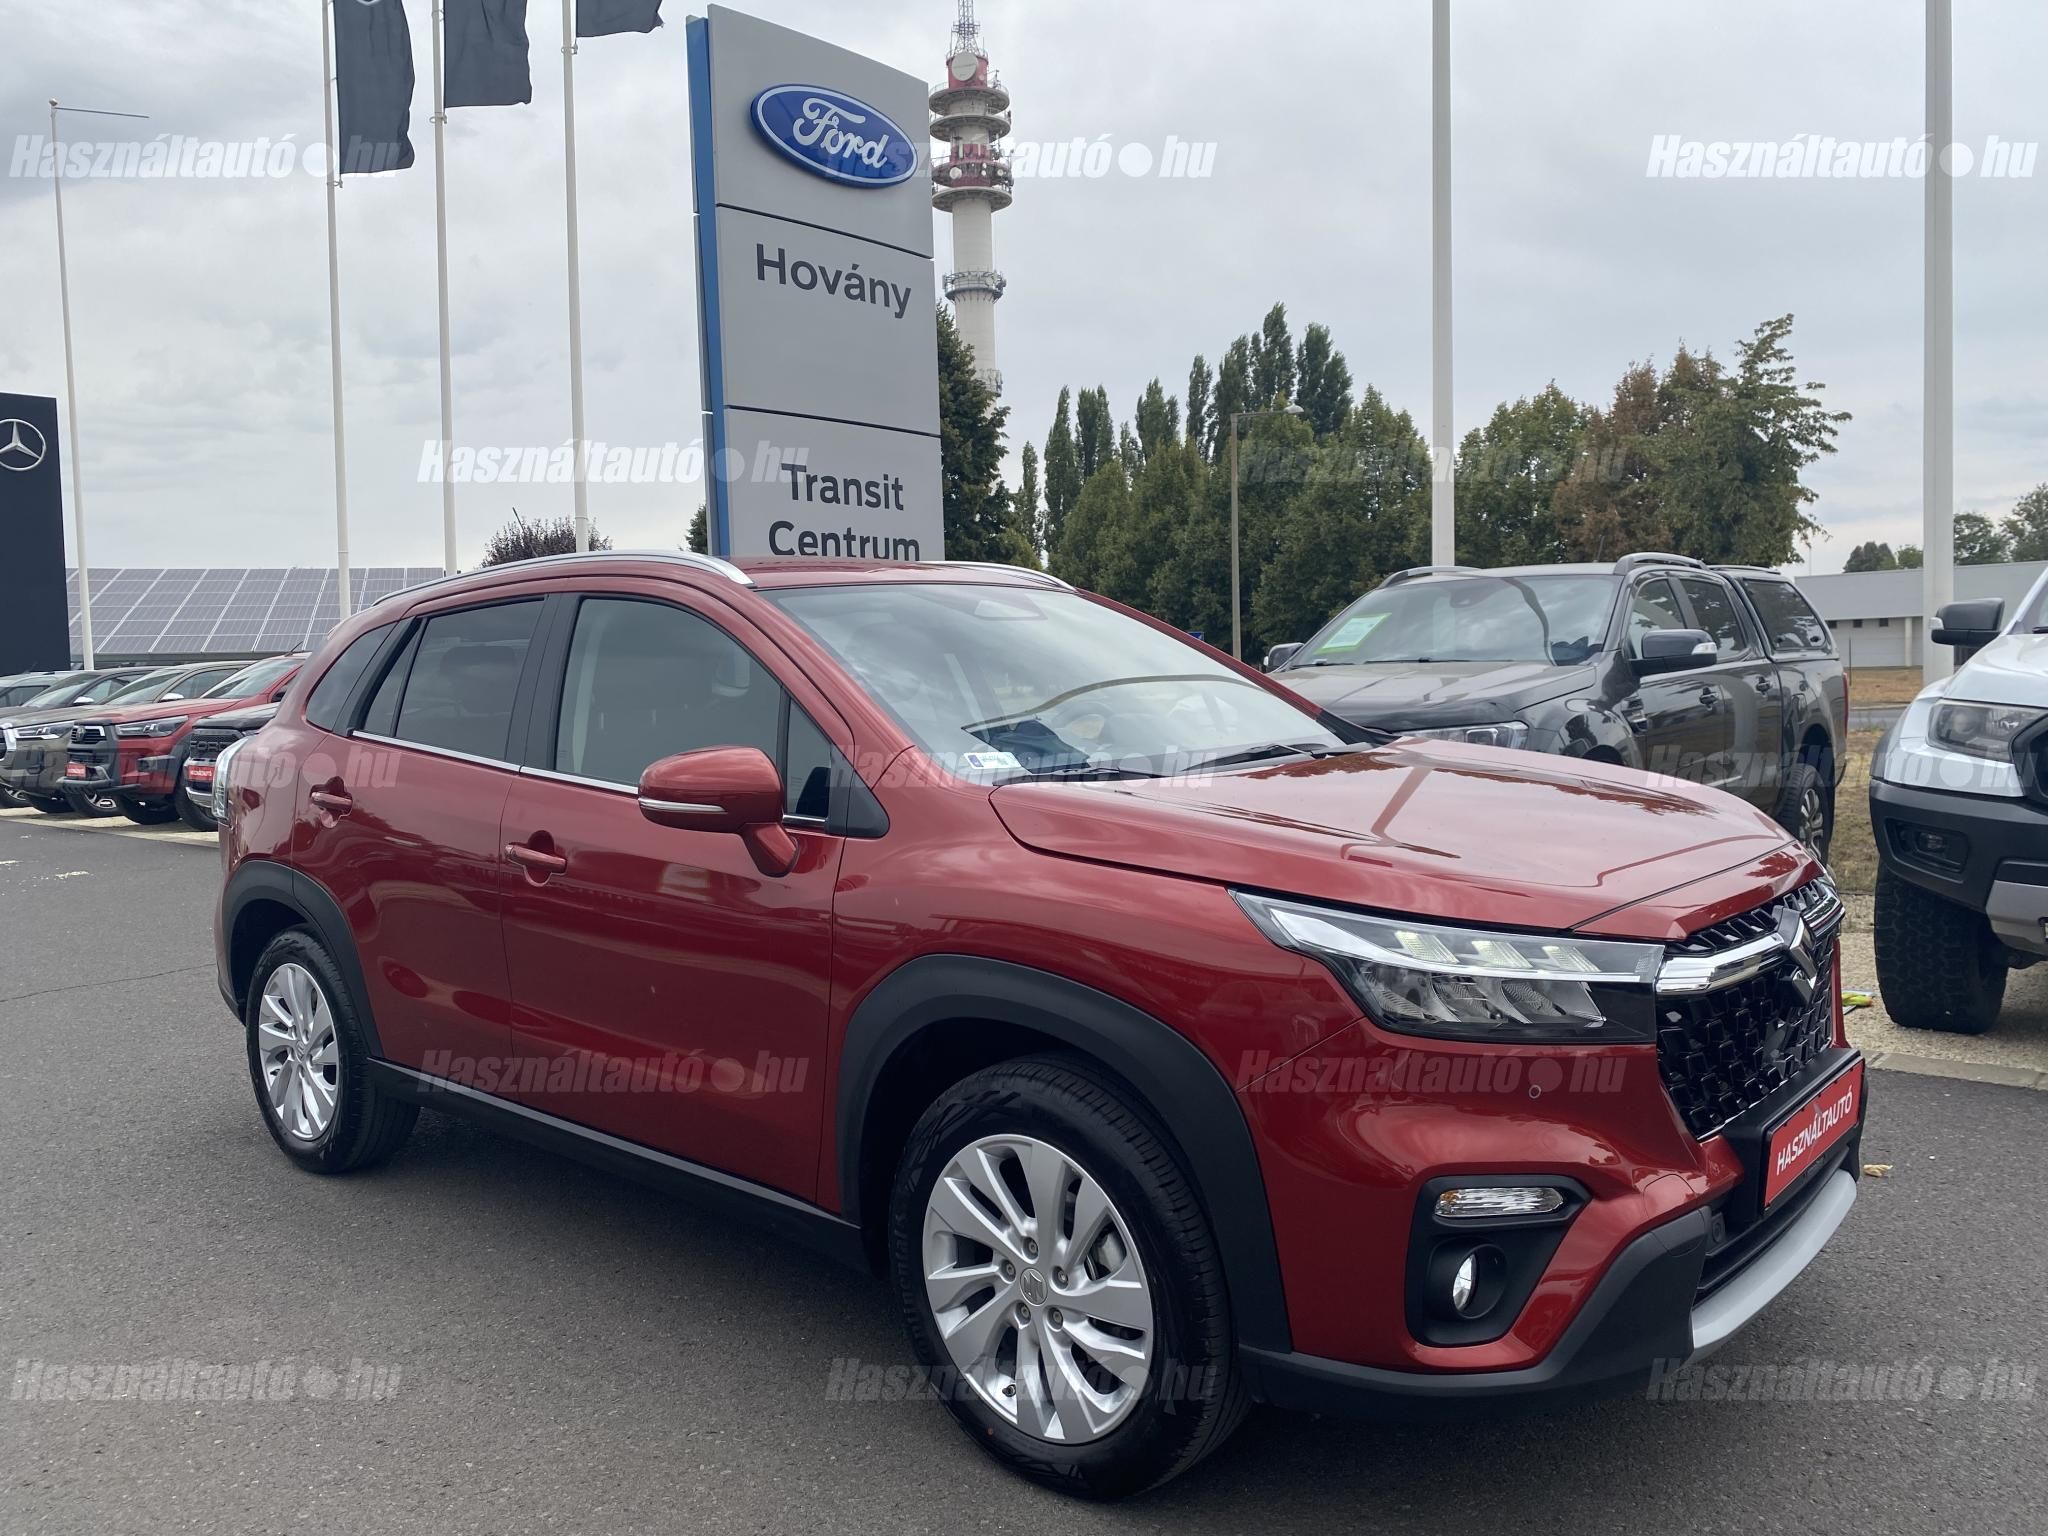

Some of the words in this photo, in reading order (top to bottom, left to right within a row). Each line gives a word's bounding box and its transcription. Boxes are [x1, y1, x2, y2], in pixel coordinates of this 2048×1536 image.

[793, 97, 890, 169] Ford
[756, 243, 912, 319] Hovány
[781, 463, 904, 511] Transit
[768, 520, 921, 562] Centrum
[1776, 1084, 1853, 1176] HASZNÁLTAUTÓ
